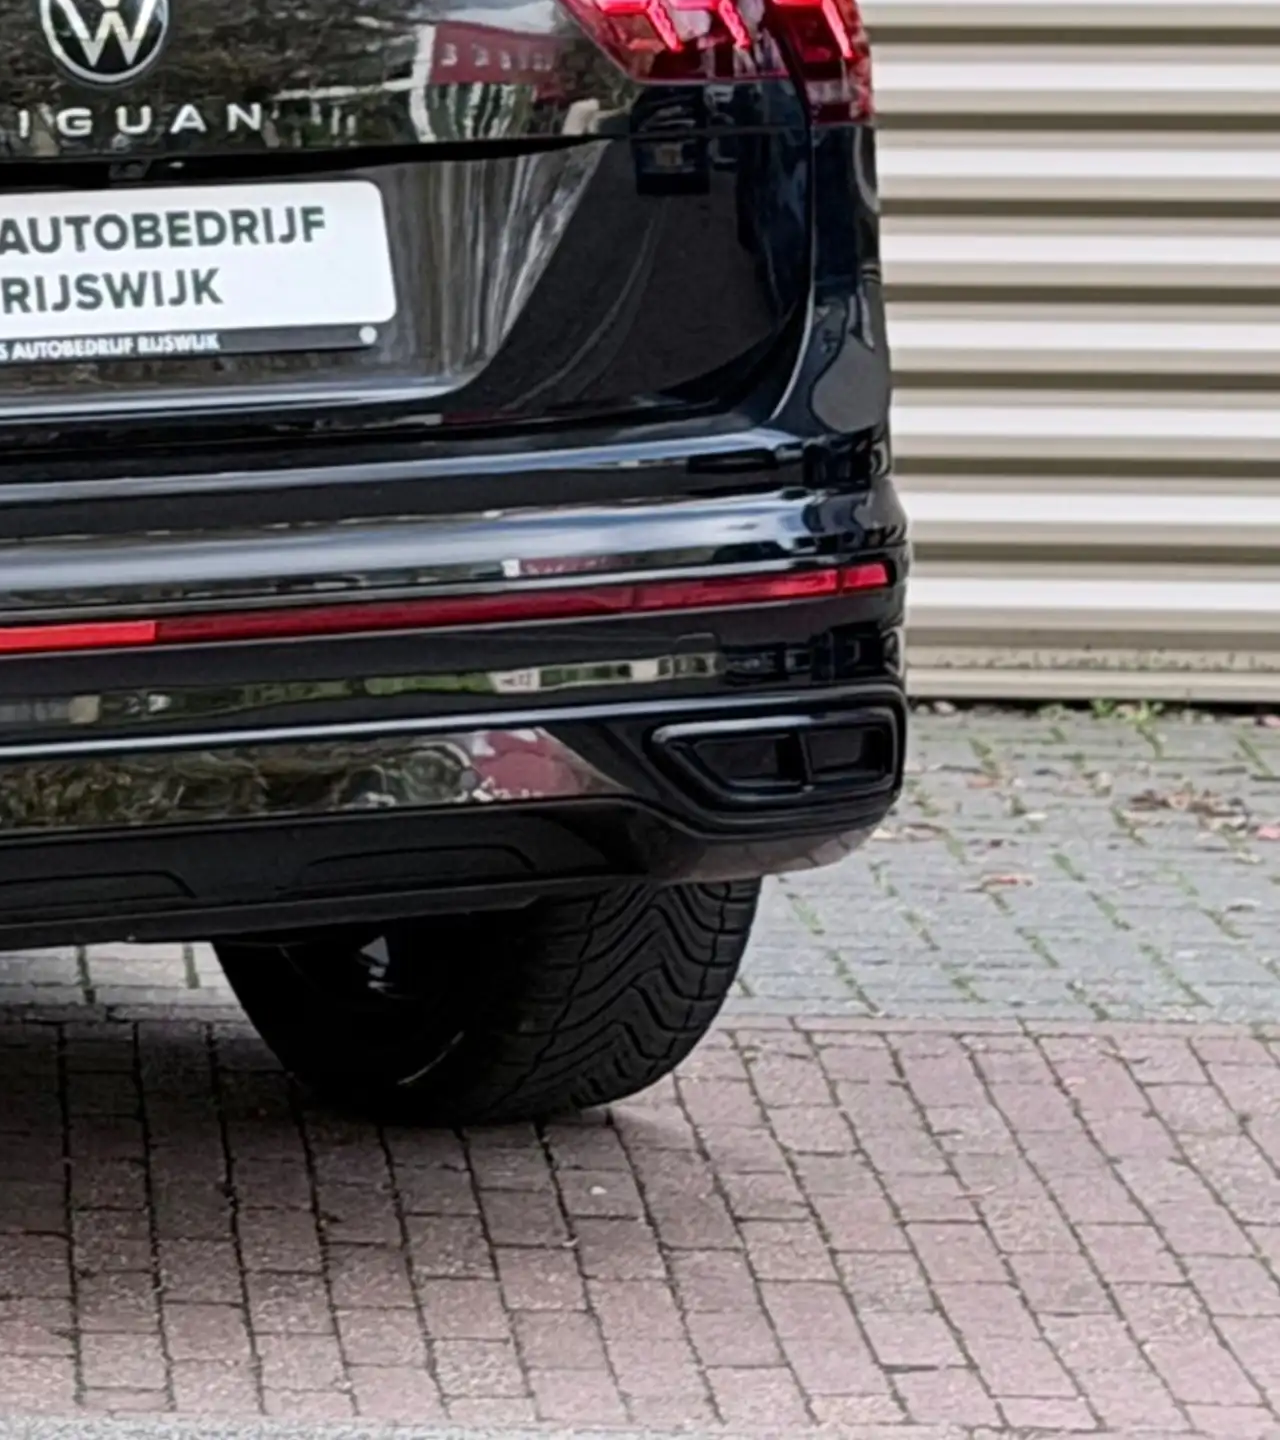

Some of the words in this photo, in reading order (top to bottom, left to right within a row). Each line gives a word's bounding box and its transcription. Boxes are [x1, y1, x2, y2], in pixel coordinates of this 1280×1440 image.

[1, 267, 224, 315] RIJSWIJK
[11, 336, 134, 360] AUTOBEDRIJF
[137, 333, 221, 353] RIJSWIJK
